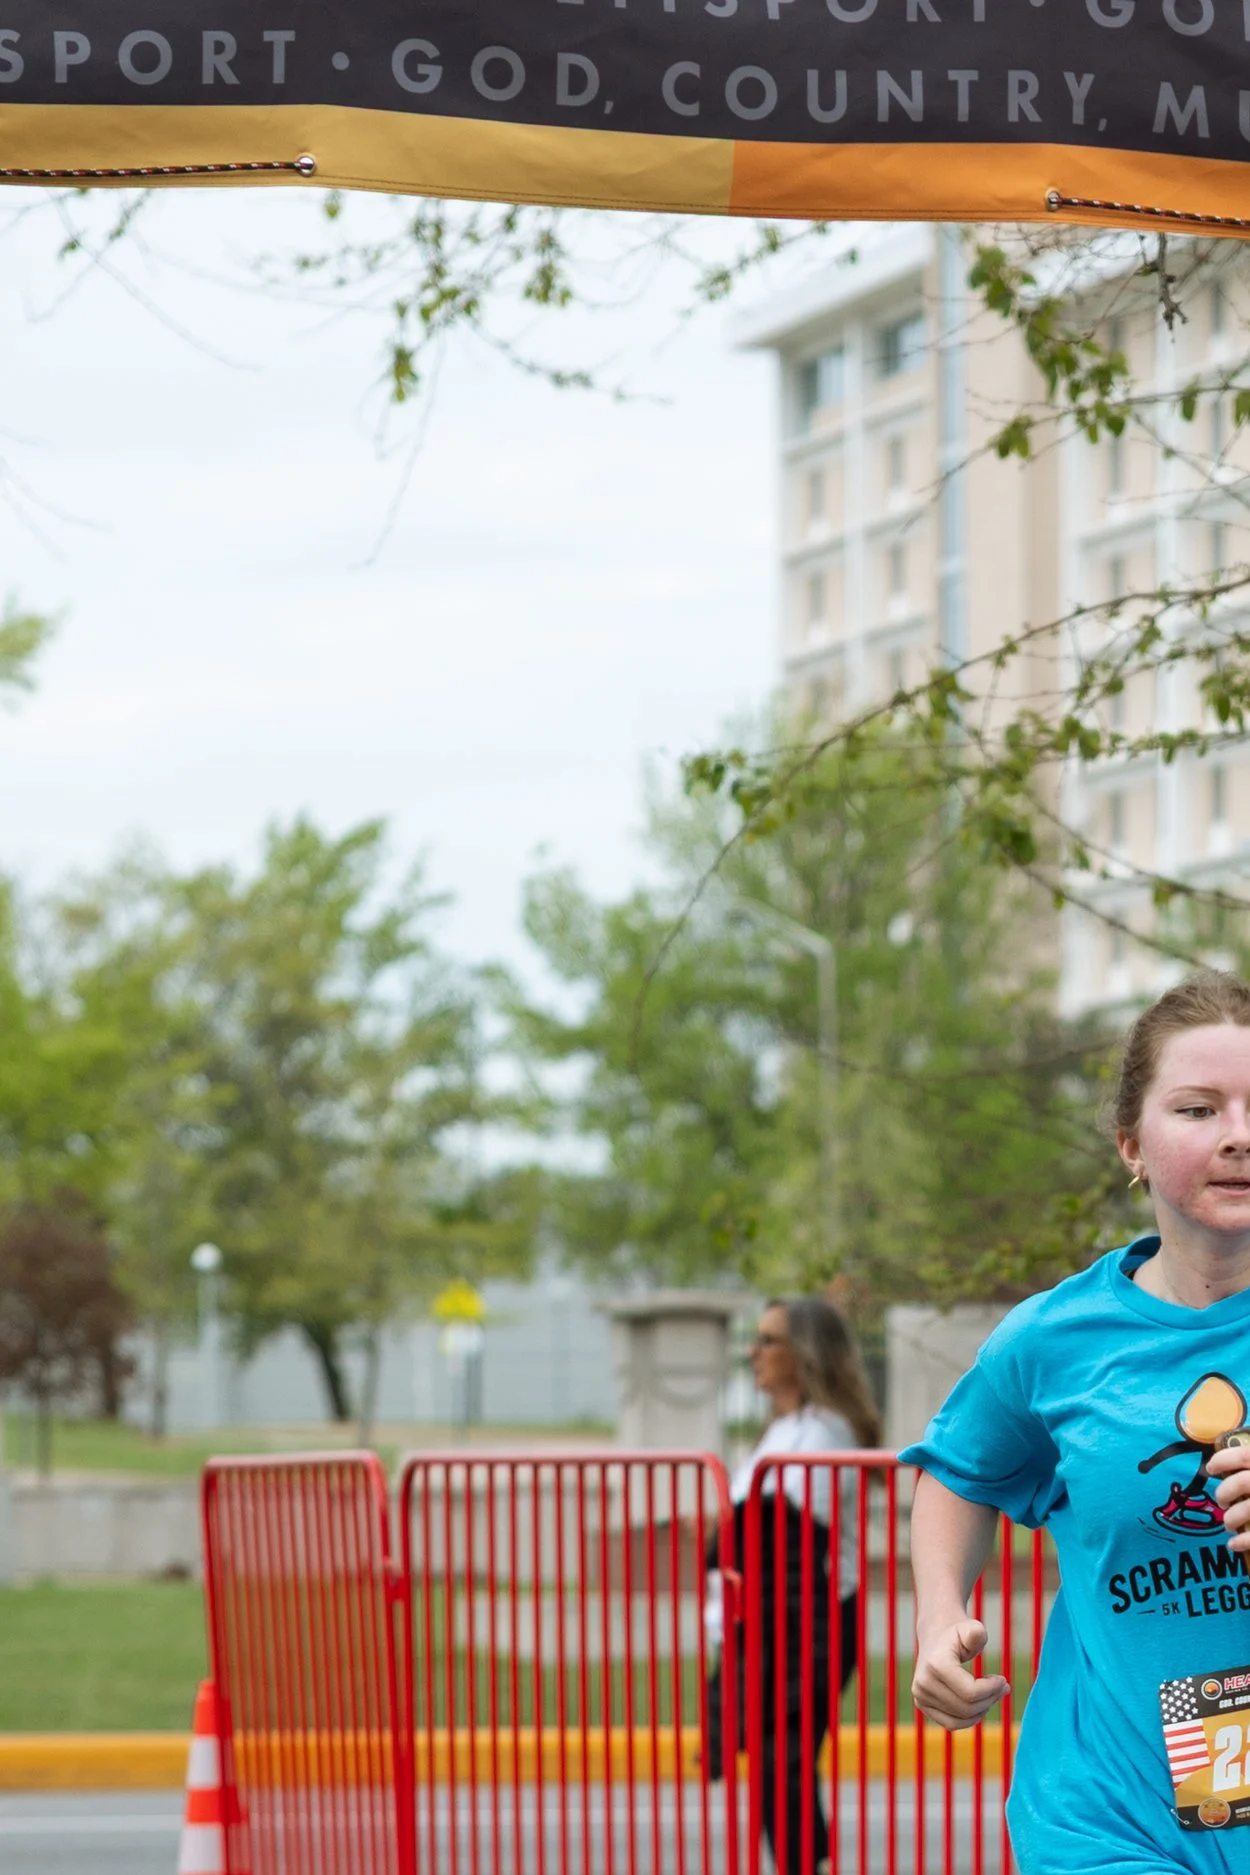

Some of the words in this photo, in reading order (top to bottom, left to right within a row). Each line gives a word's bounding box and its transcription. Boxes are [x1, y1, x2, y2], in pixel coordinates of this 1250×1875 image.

[391, 38, 614, 115] GOD,
[661, 61, 1108, 132] COUNTRY,
[1161, 1602, 1181, 1616] 5K
